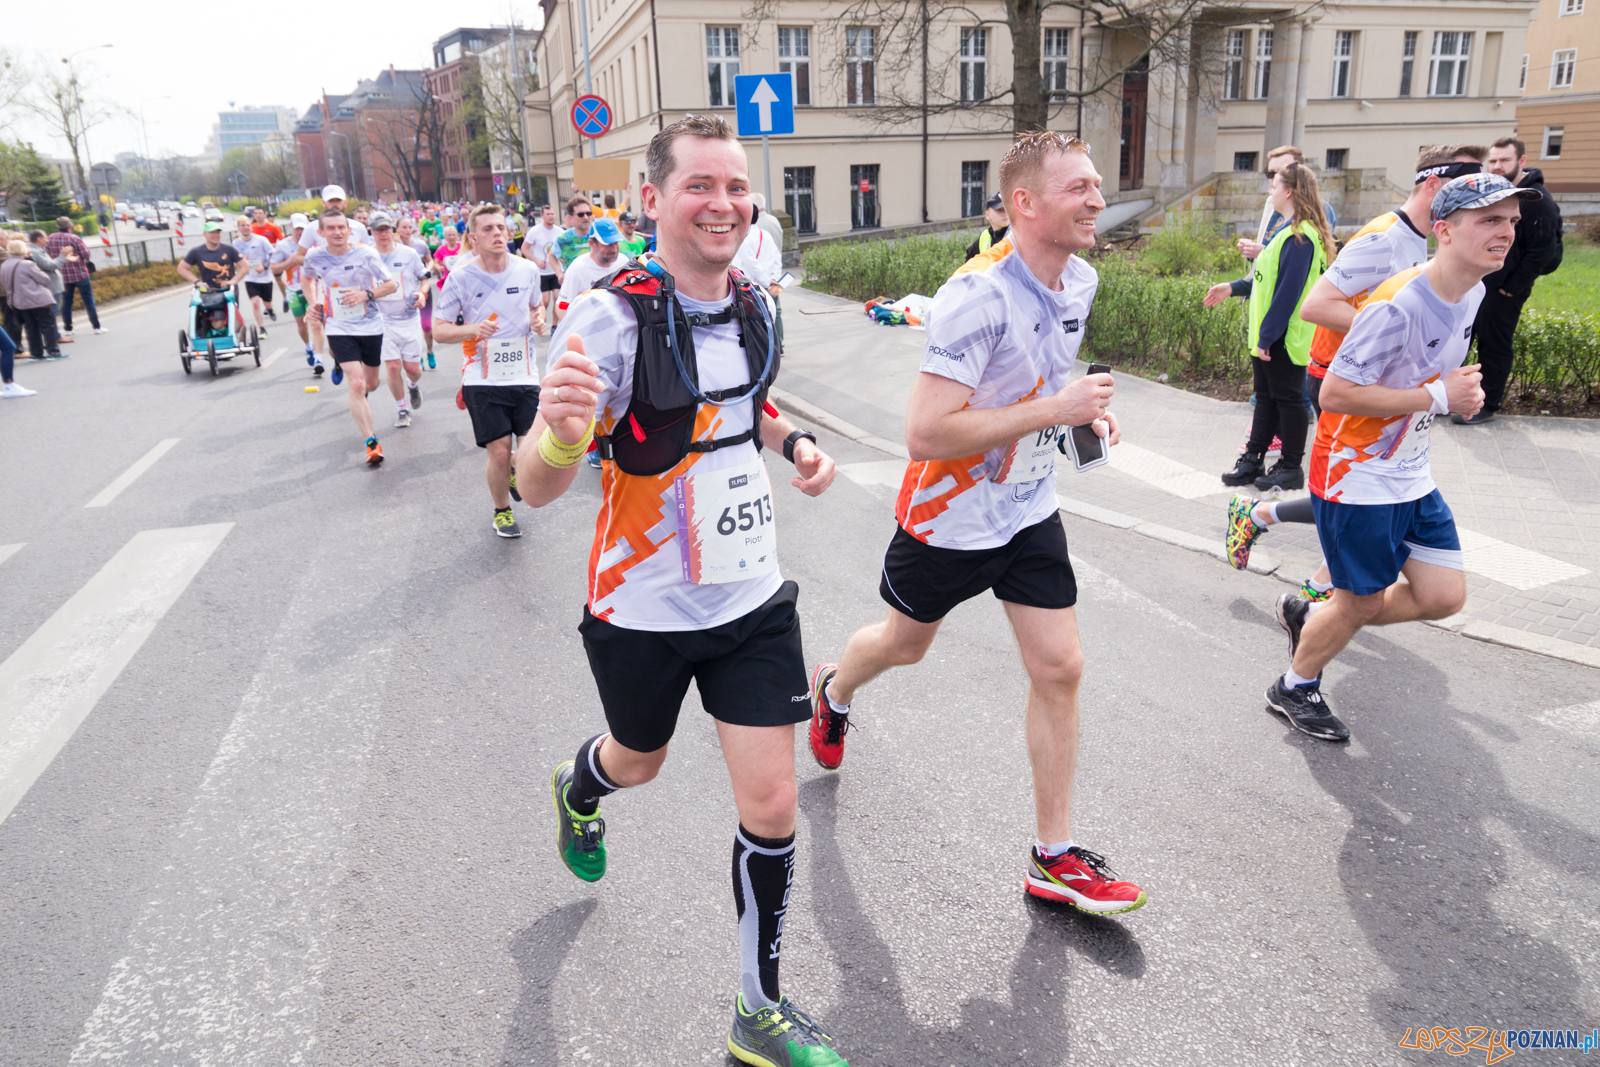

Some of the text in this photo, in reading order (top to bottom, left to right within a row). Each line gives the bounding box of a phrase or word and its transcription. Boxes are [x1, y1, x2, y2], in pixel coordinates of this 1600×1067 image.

[494, 350, 522, 362] 2888
[717, 494, 772, 535] 6513
[745, 535, 763, 546] Piotr
